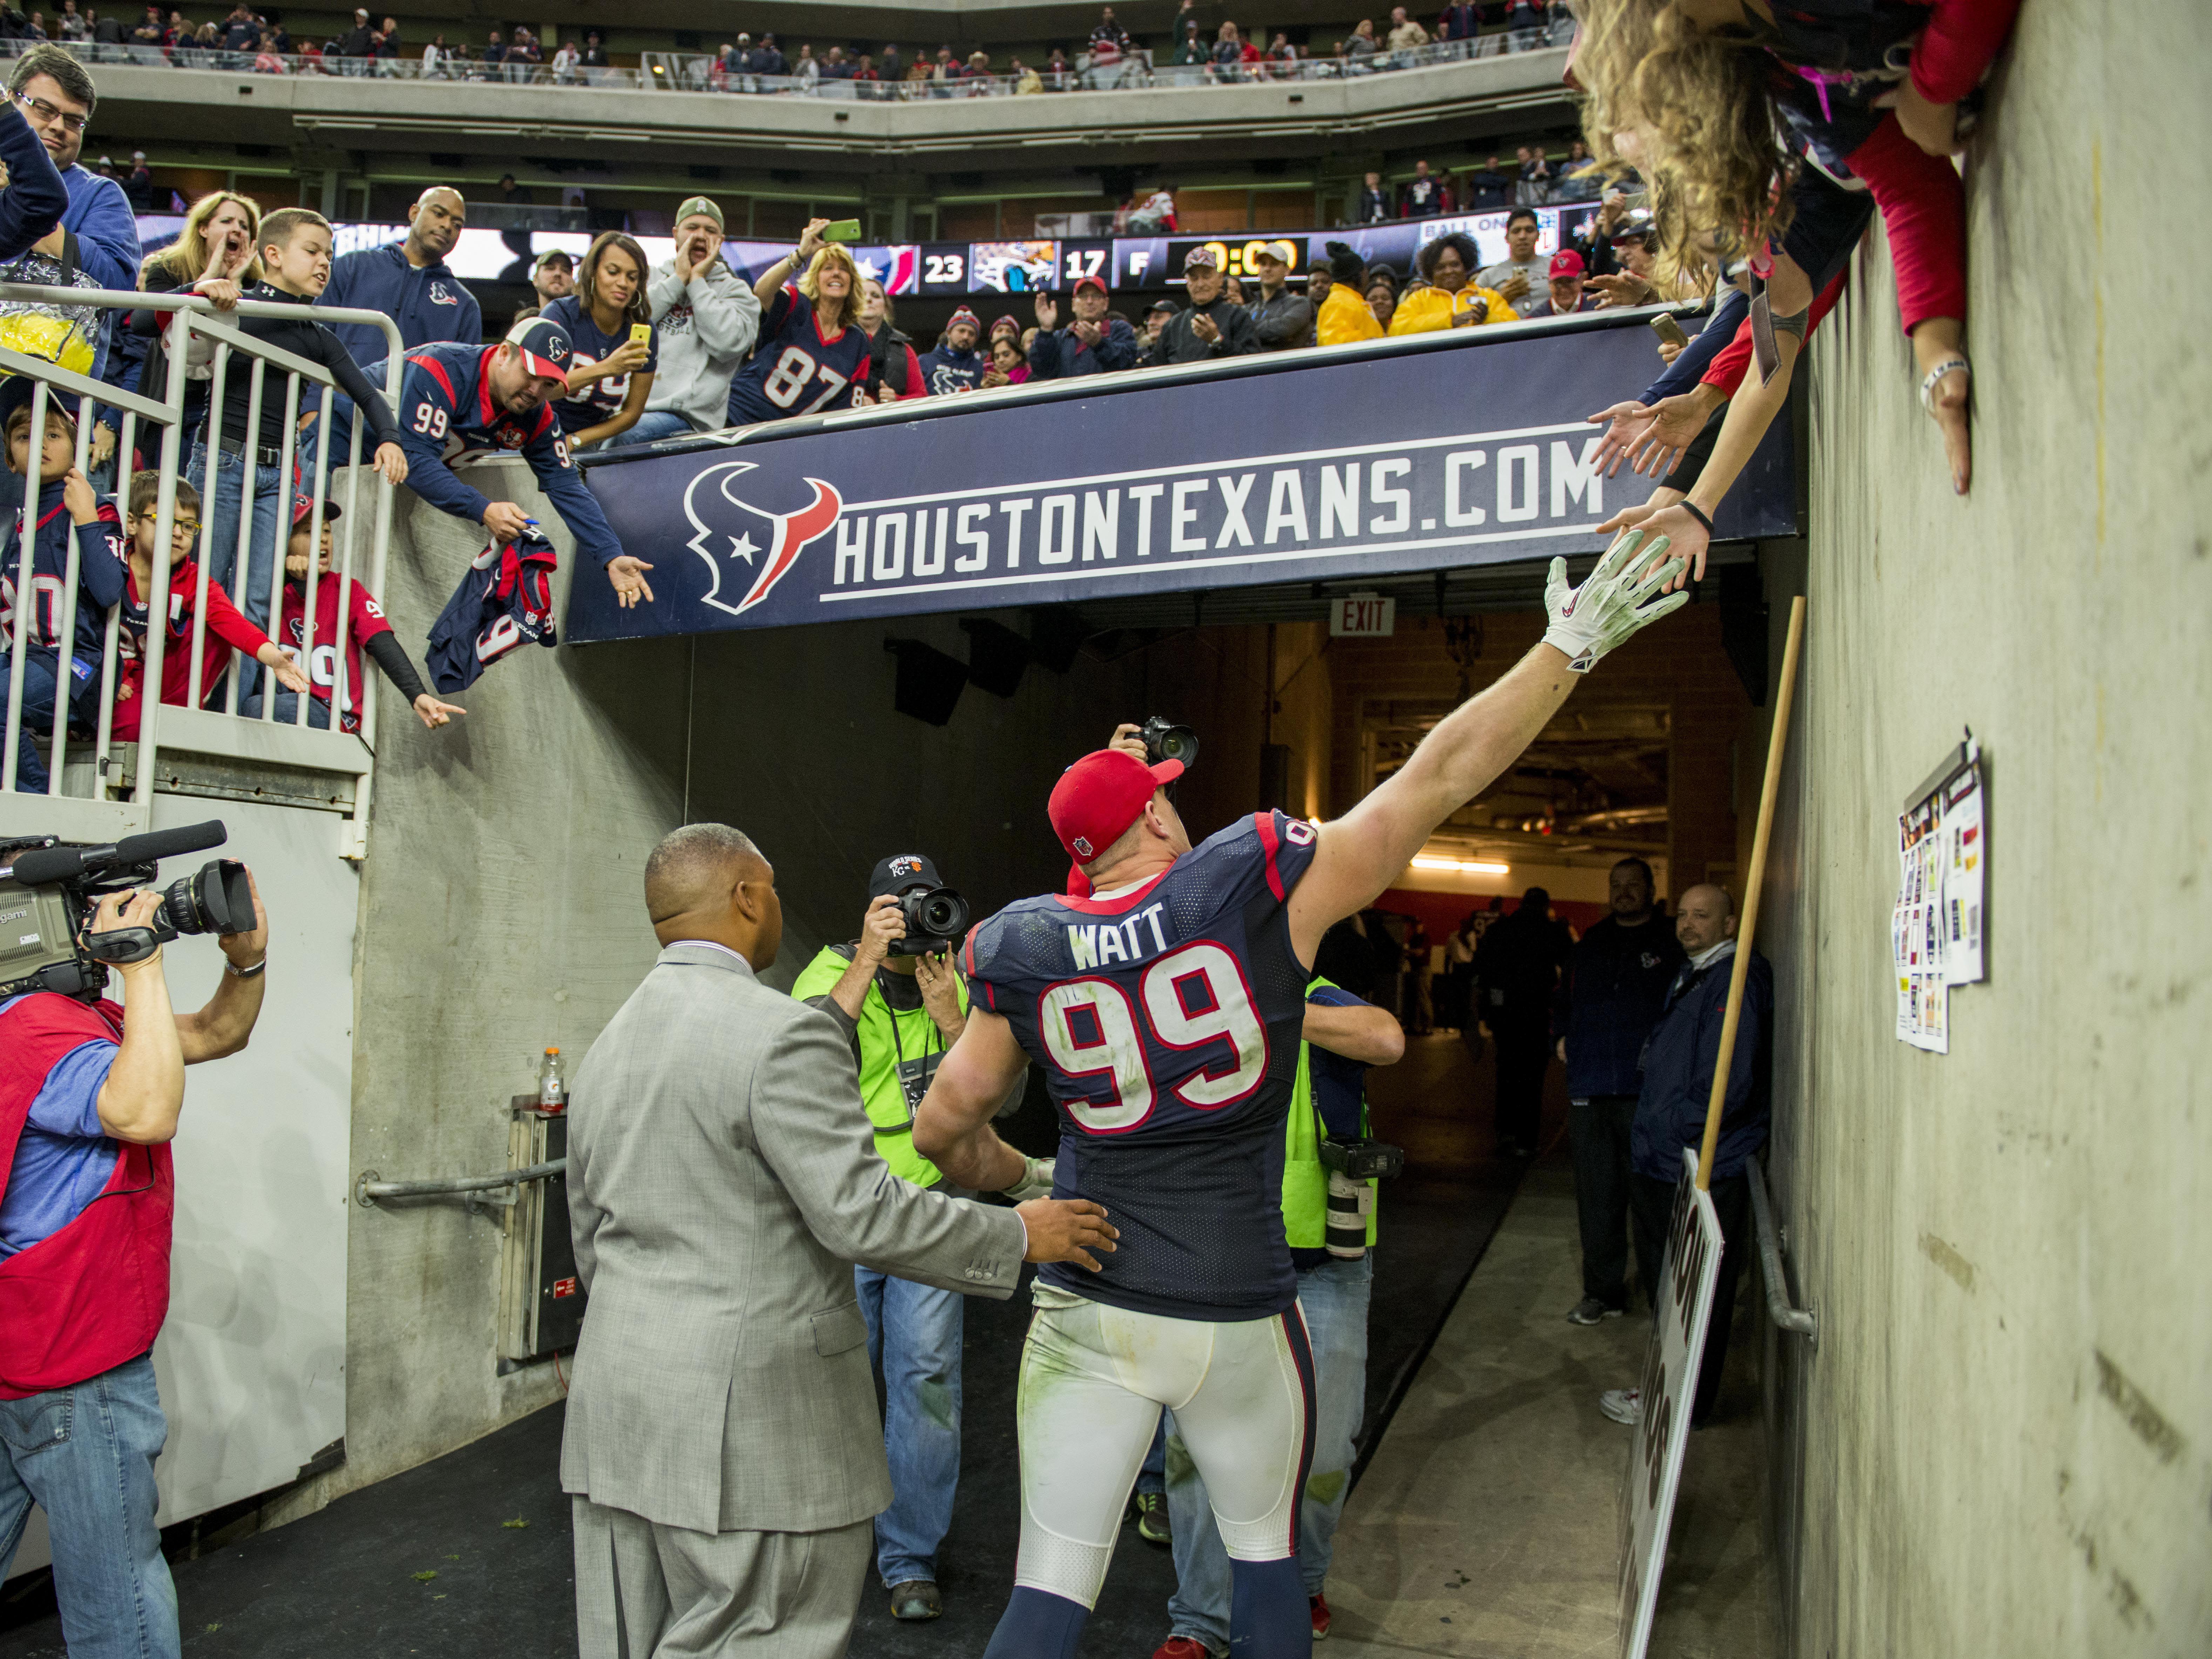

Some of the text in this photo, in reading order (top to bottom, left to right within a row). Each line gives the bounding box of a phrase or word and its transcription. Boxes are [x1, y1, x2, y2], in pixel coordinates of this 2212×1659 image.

[1424, 215, 1507, 238] BALL ON
[925, 255, 963, 283] 23
[1066, 250, 1105, 279] 17
[1130, 251, 1149, 276] F
[763, 345, 849, 418] 87
[851, 385, 865, 408] 8
[413, 402, 448, 439] 99
[833, 436, 1603, 585] HOUSTONTEXANS.COM
[126, 617, 148, 626] TEXAN
[366, 601, 385, 618] 9
[1342, 600, 1386, 631] EXIT
[888, 857, 905, 869] WORLD
[892, 866, 905, 877] KC
[1068, 901, 1168, 971] WATT
[1037, 939, 1271, 1135] 99
[547, 1080, 559, 1093] G
